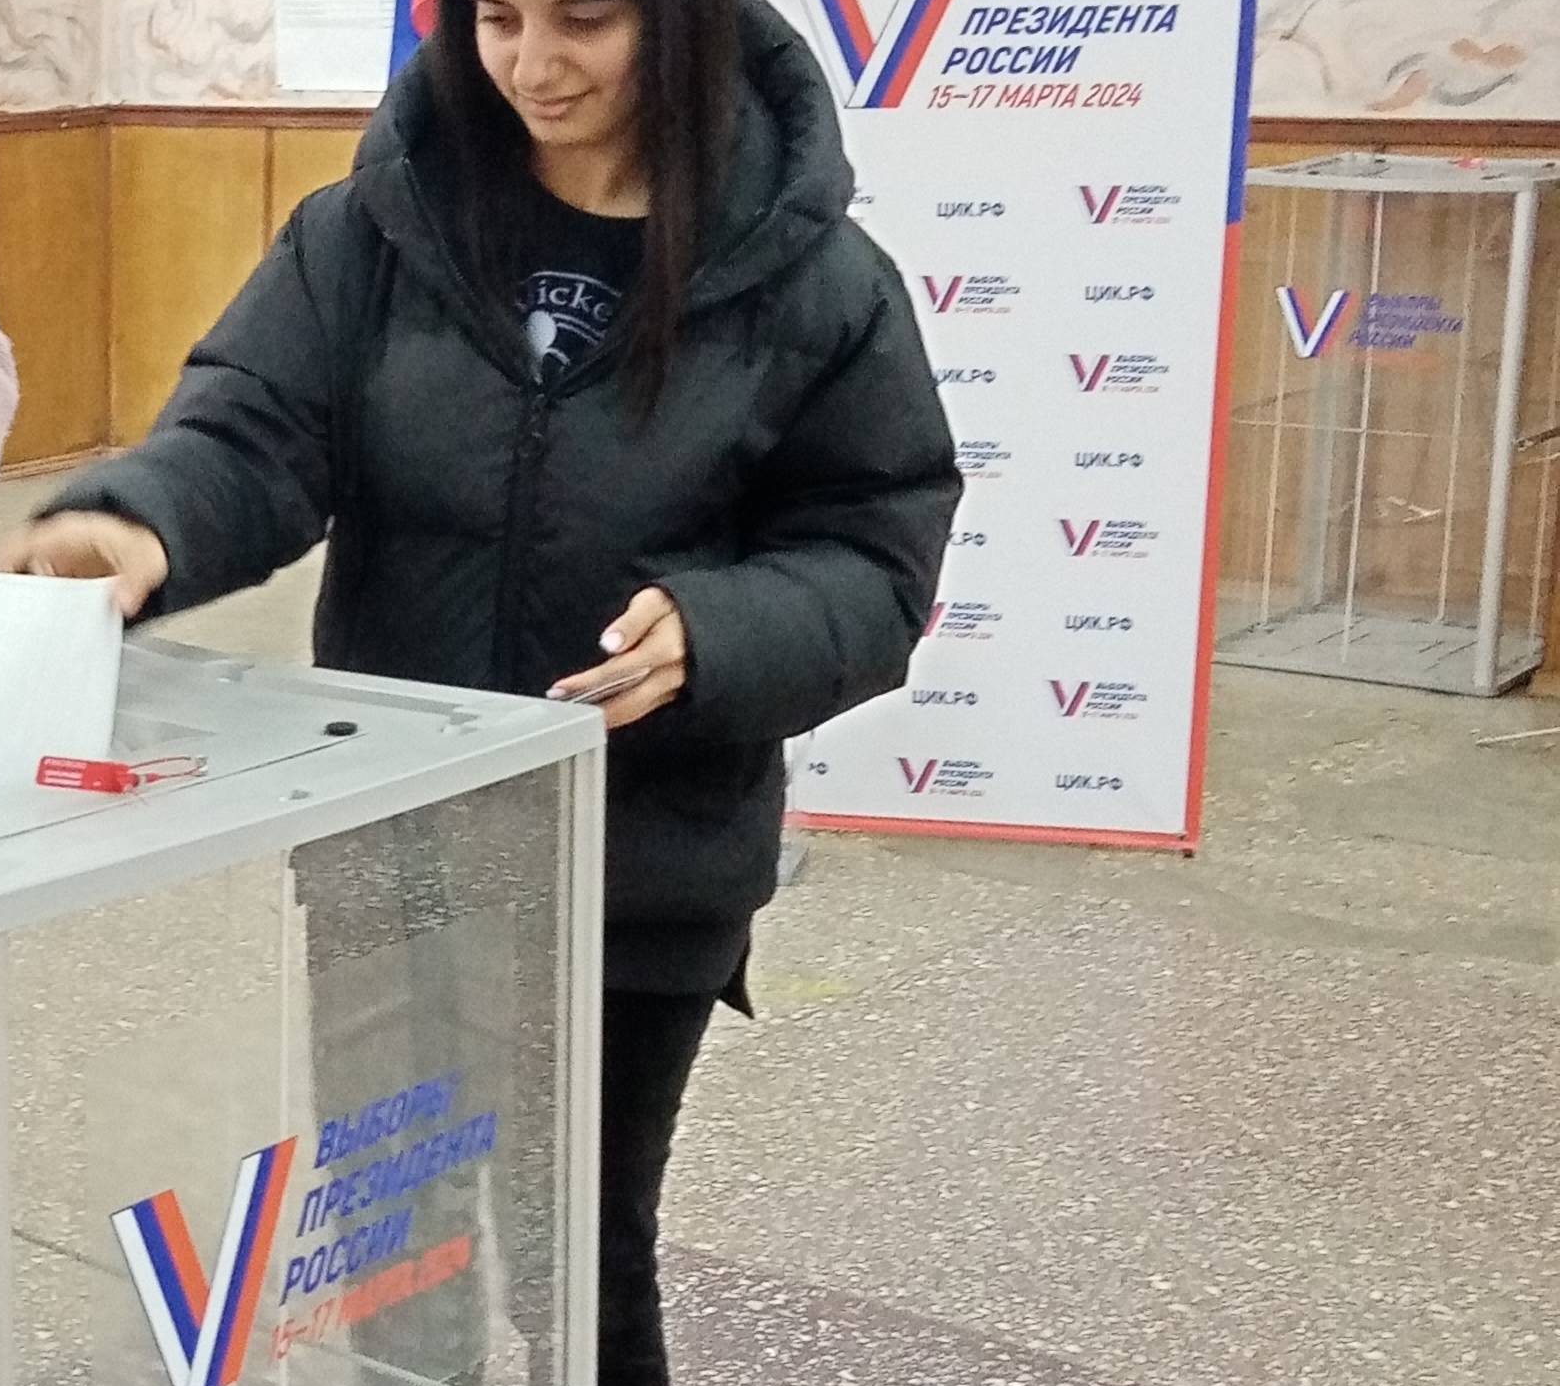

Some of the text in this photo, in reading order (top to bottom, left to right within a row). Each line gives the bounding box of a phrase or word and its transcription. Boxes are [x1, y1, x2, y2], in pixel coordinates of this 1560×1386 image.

[960, 4, 1180, 38] ПРЕЗИДЕНТА
[941, 45, 1083, 75] РОССИИ
[994, 84, 1080, 109] МАРТА
[1082, 83, 1142, 108] 2024
[936, 201, 1006, 220] ЦИК.РФ
[1085, 286, 1155, 303] ЦИК.РФ
[1075, 452, 1144, 469] ЦИК.РФ
[1065, 615, 1133, 633] ЦИК.РФ
[912, 690, 979, 707] ЦИК.РФ
[1055, 774, 1124, 791] ЦИК.РФ
